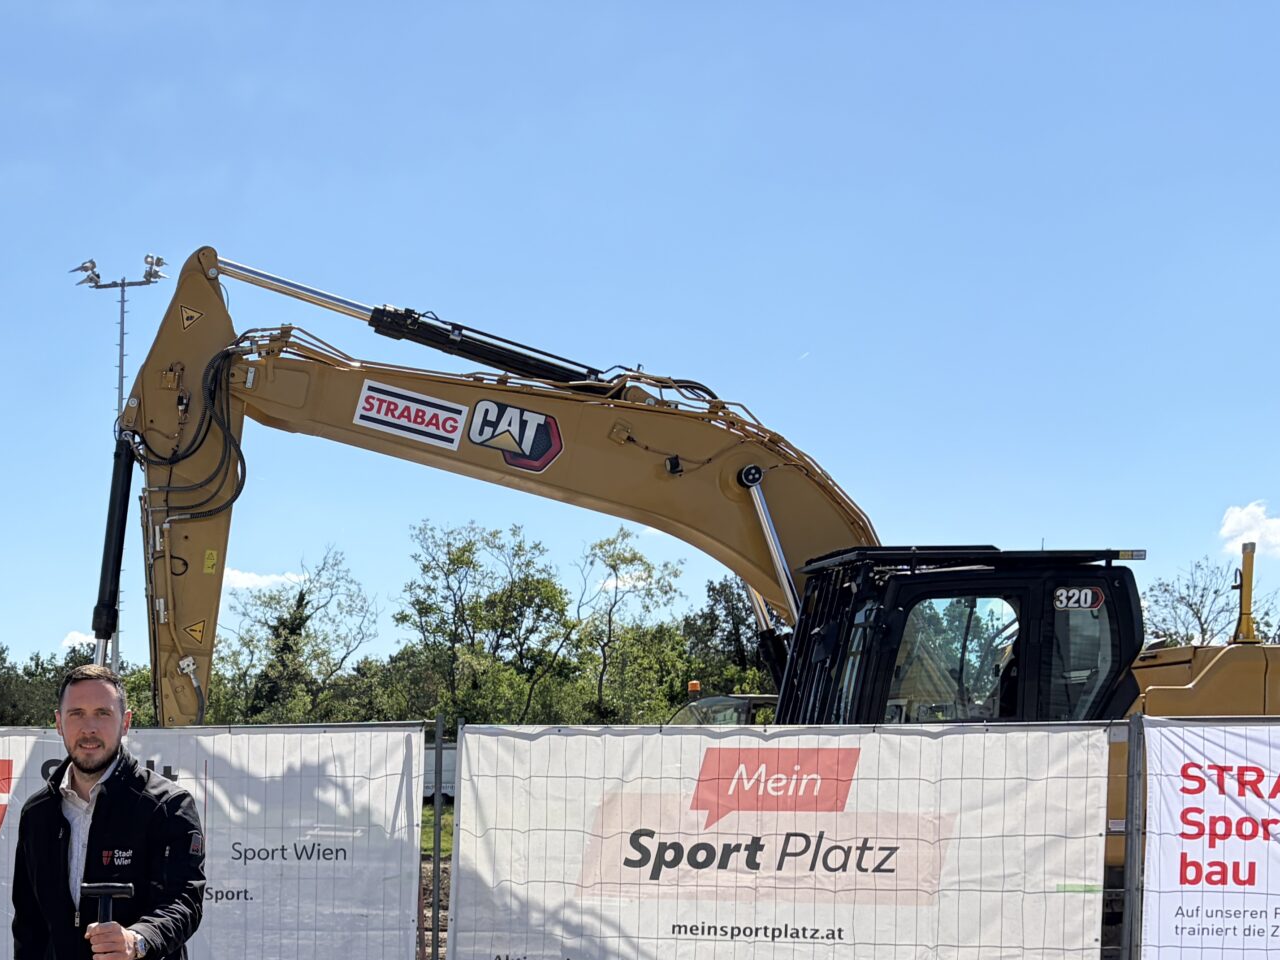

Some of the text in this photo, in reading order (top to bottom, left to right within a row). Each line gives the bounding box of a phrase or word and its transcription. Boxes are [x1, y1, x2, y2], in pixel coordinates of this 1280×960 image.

[362, 395, 459, 435] STRABAG
[470, 400, 546, 456] CAT
[1055, 588, 1092, 608] 320
[727, 763, 822, 796] Mein
[231, 842, 347, 865] Sport Wien
[623, 828, 900, 880] Sport Platz
[1179, 852, 1256, 886] bau
[205, 887, 253, 903] Sport.
[1174, 906, 1201, 918] Auf
[1205, 908, 1268, 919] unseren
[671, 921, 845, 941] meinsportplatz.at
[1174, 924, 1238, 936] trainiert
[1243, 924, 1266, 937] die
